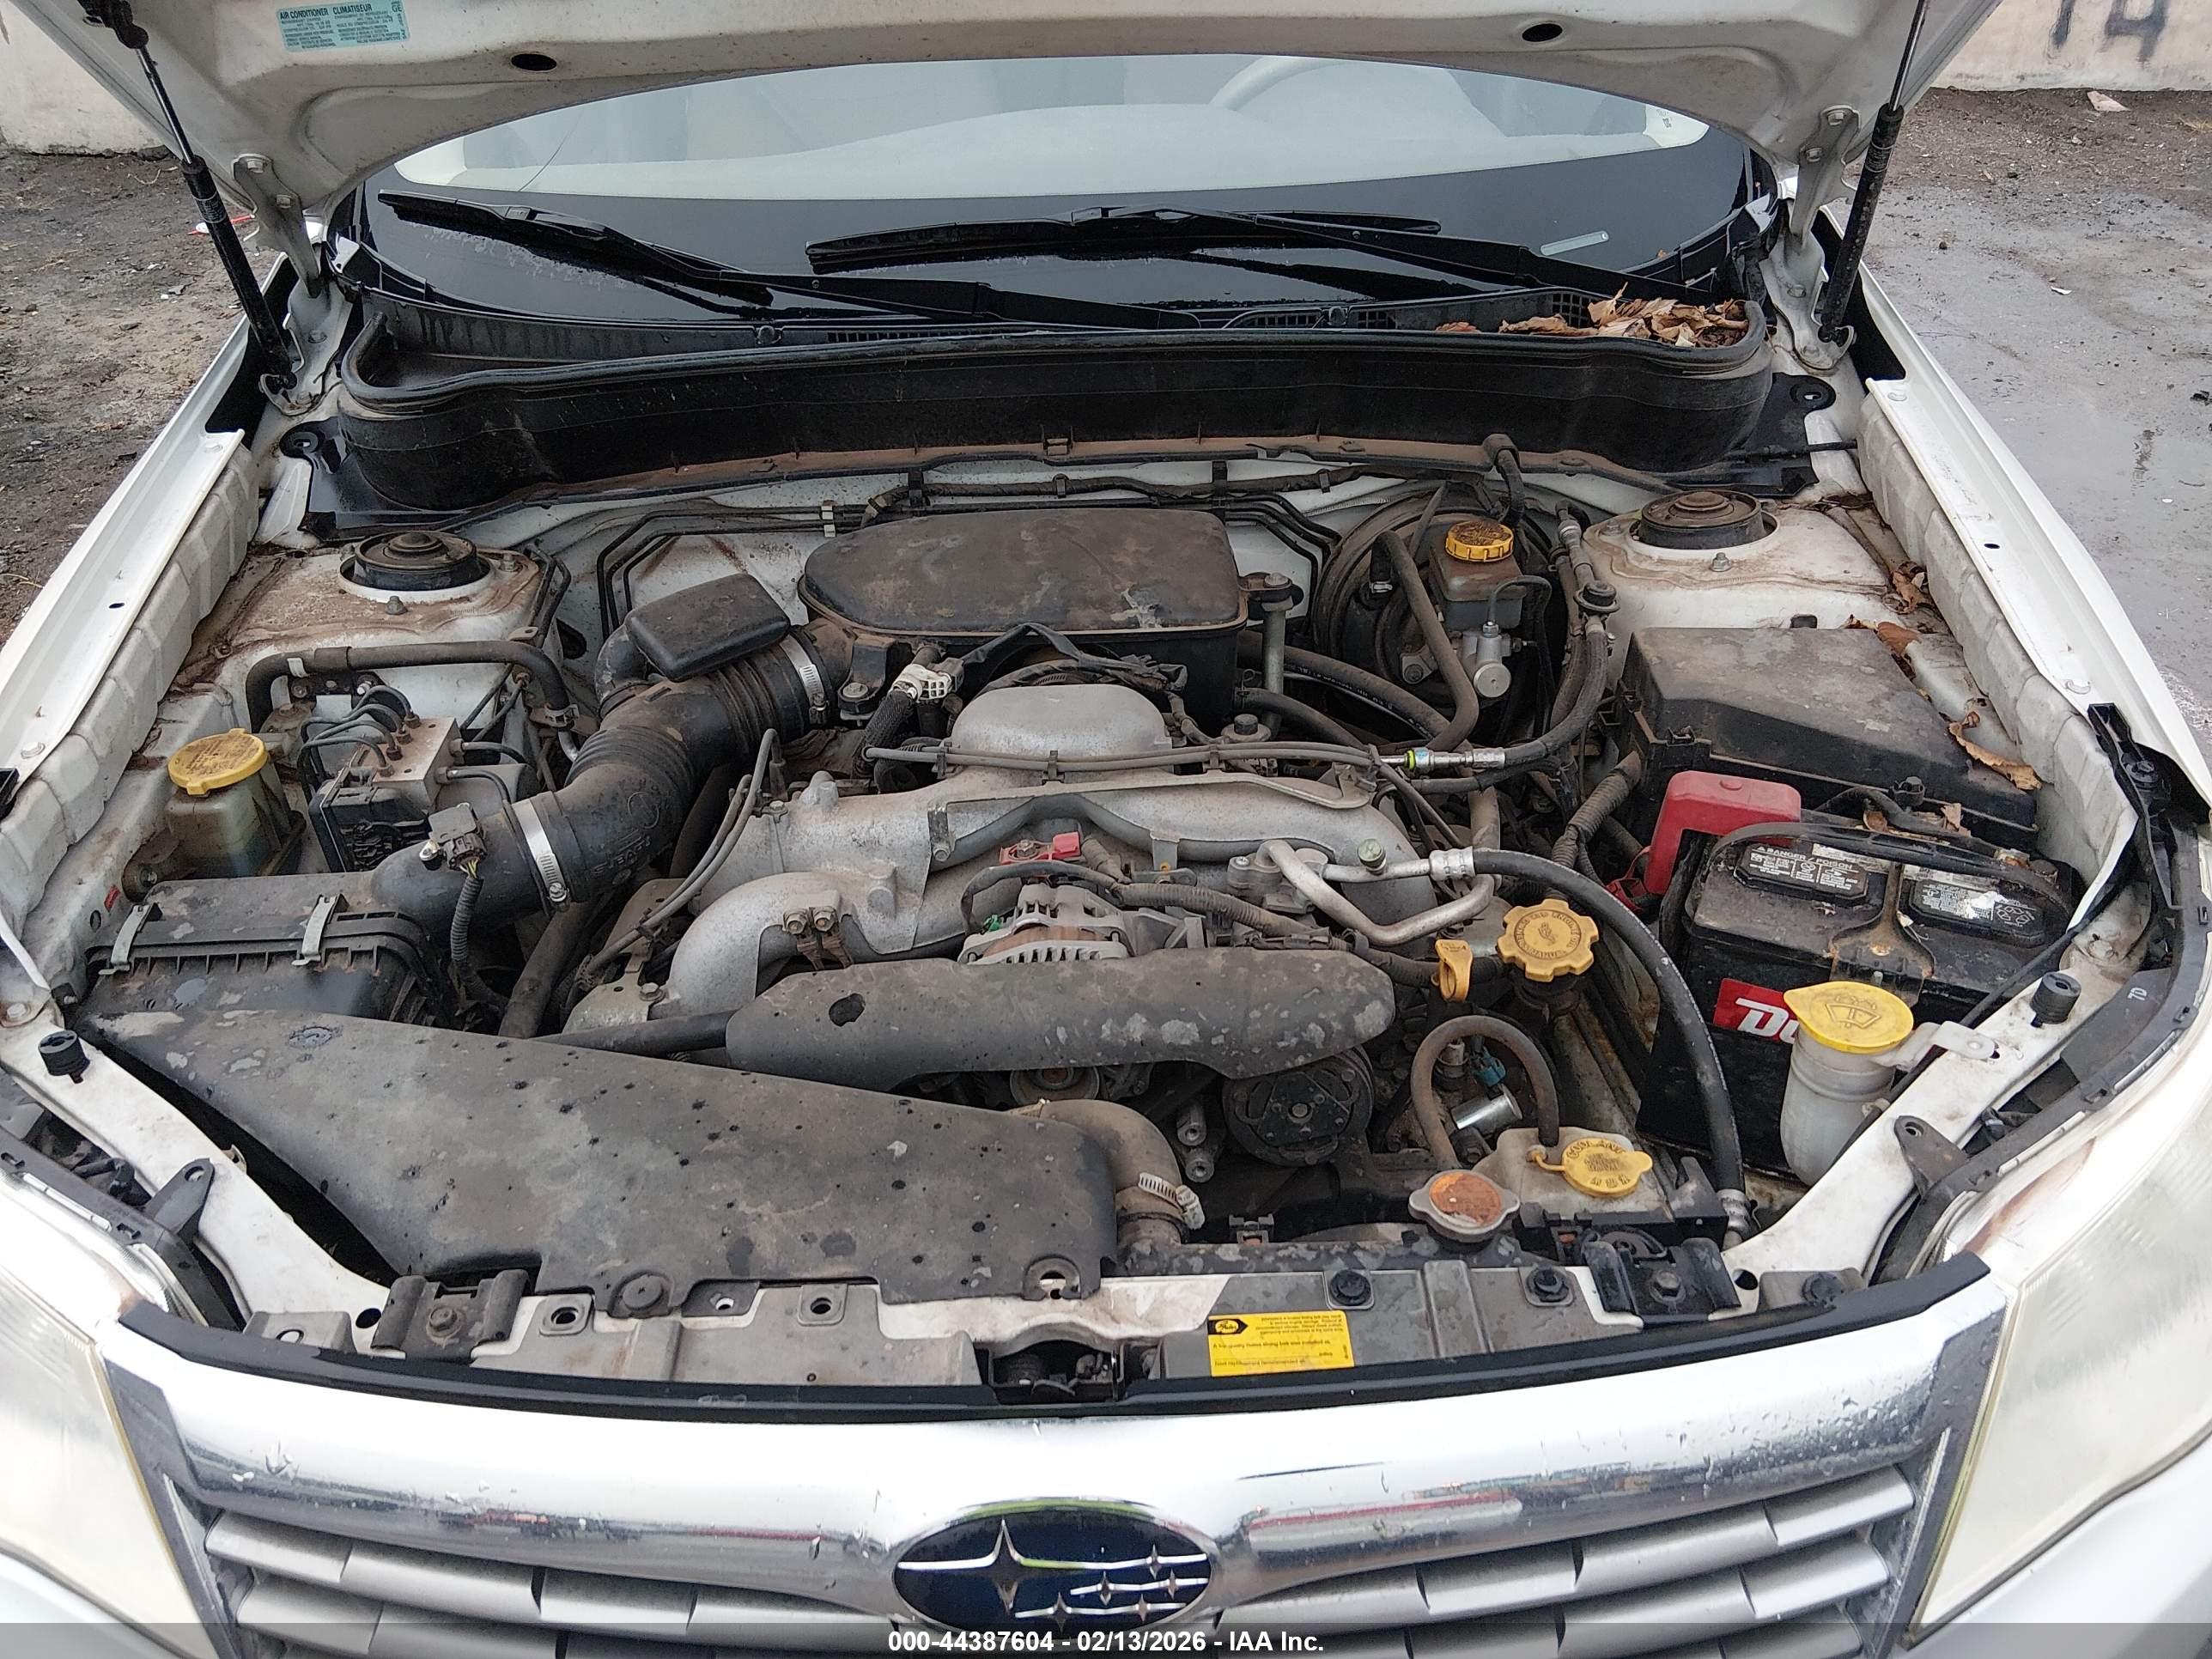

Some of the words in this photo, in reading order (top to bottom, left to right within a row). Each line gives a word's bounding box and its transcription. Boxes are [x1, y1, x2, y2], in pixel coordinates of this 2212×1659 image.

[280, 10, 290, 21] AIR
[290, 8, 329, 19] CONDITIONER
[332, 3, 372, 15] CLIMATISEUR
[1766, 847, 1807, 861] DANGER
[1815, 857, 1853, 870] POISON
